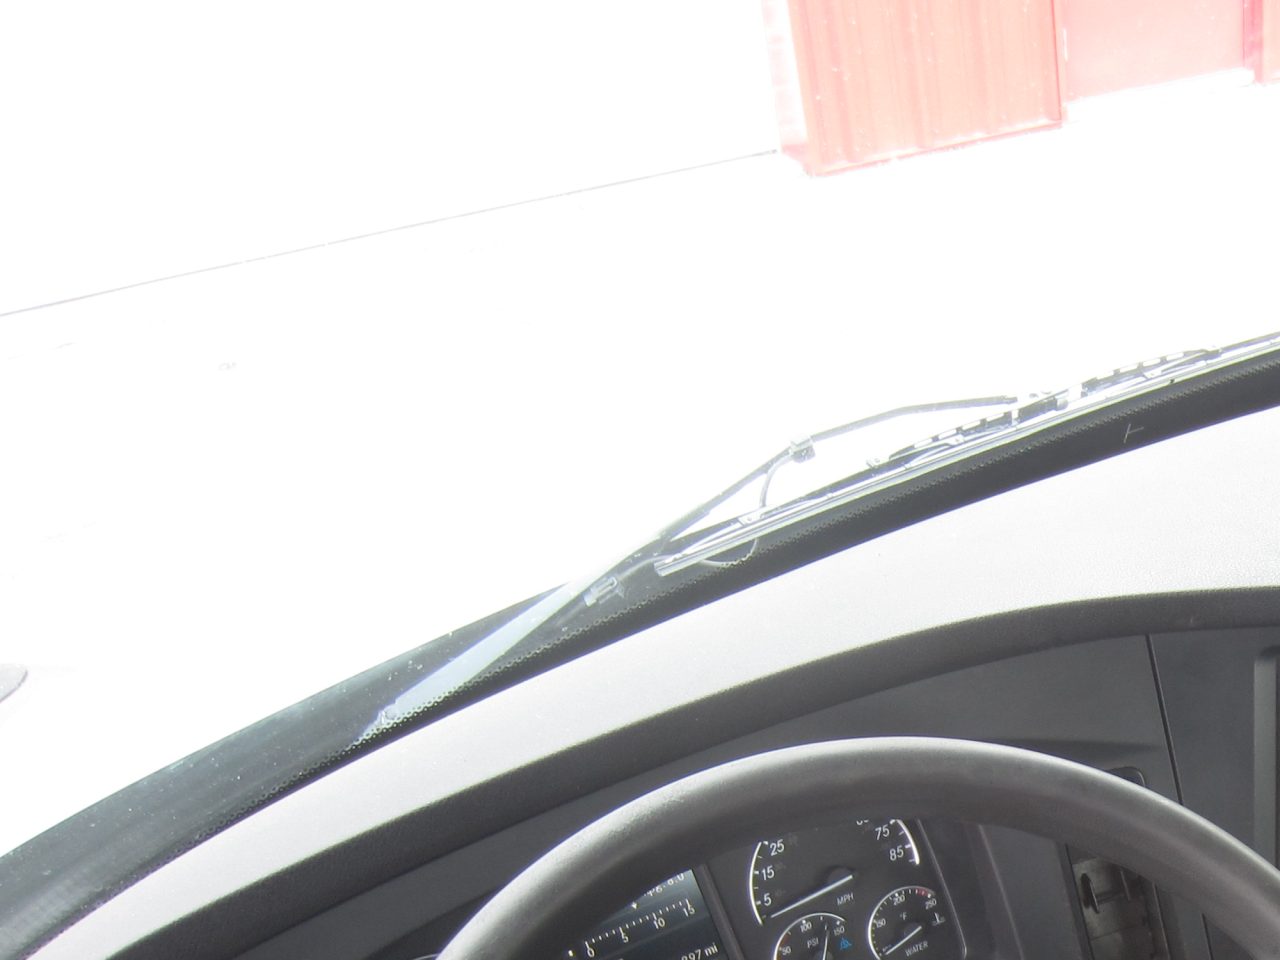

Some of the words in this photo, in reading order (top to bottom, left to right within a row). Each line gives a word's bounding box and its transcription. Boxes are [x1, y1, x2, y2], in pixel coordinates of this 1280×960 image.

[875, 826, 890, 841] 75
[770, 839, 785, 856] 25
[889, 845, 904, 861] 85
[762, 865, 775, 881] 15
[764, 893, 772, 906] 5
[836, 893, 854, 906] MPH
[683, 906, 695, 917] 15
[653, 918, 666, 930] 10
[704, 942, 719, 957] mi
[807, 937, 819, 948] PSI
[904, 941, 929, 957] WATER
[587, 948, 595, 958] 0
